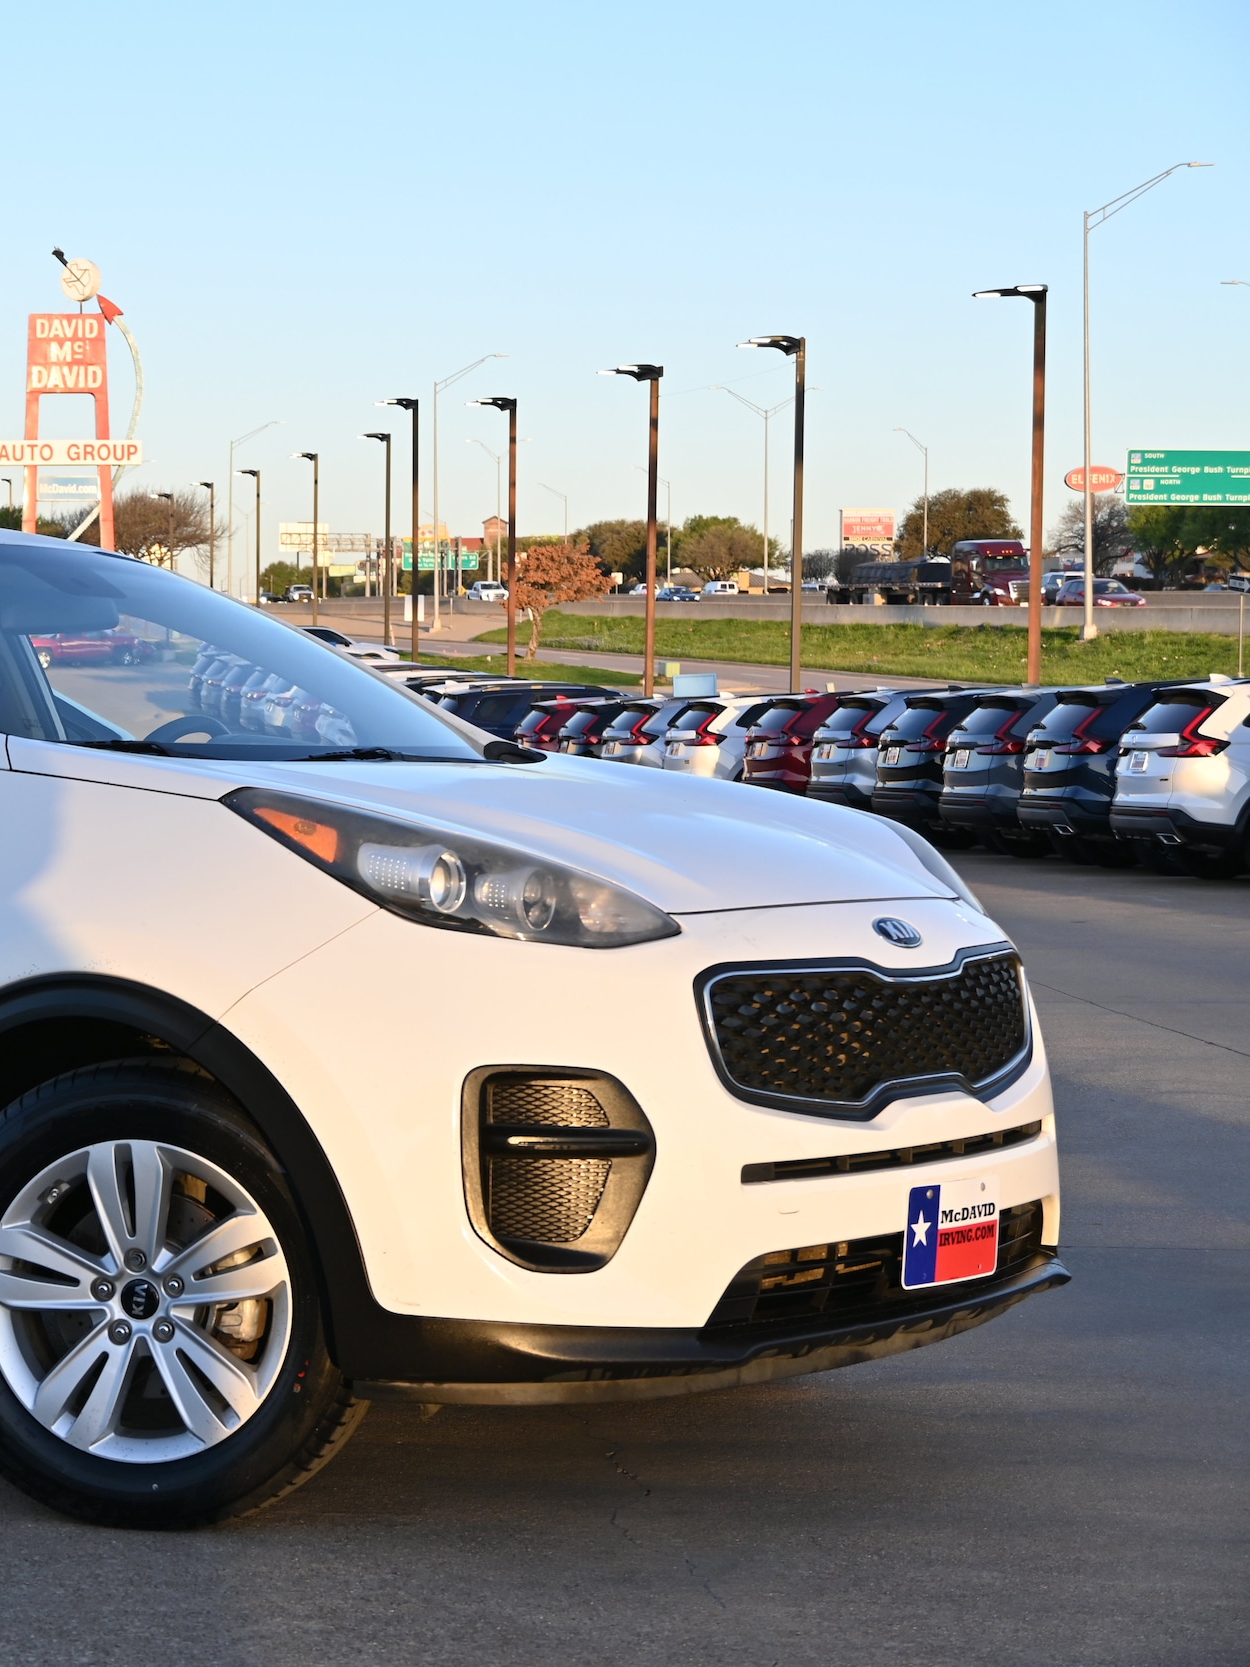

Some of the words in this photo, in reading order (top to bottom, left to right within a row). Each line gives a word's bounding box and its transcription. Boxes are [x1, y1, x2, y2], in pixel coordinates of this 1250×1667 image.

[35, 318, 99, 339] DAVID
[31, 365, 103, 389] DAVID
[66, 443, 138, 462] GROUP
[1071, 473, 1084, 485] EL
[1090, 473, 1116, 485] ENIX
[1130, 465, 1168, 473] President
[1171, 465, 1201, 475] George
[1203, 465, 1224, 473] Bush
[39, 483, 98, 494] McDavid.com
[1128, 493, 1167, 501] President
[1170, 493, 1199, 503] George
[1202, 493, 1222, 501] Bush
[941, 1202, 996, 1224] McDAVID
[938, 1224, 995, 1247] IRVING.COM
[131, 1283, 149, 1316] KIA
